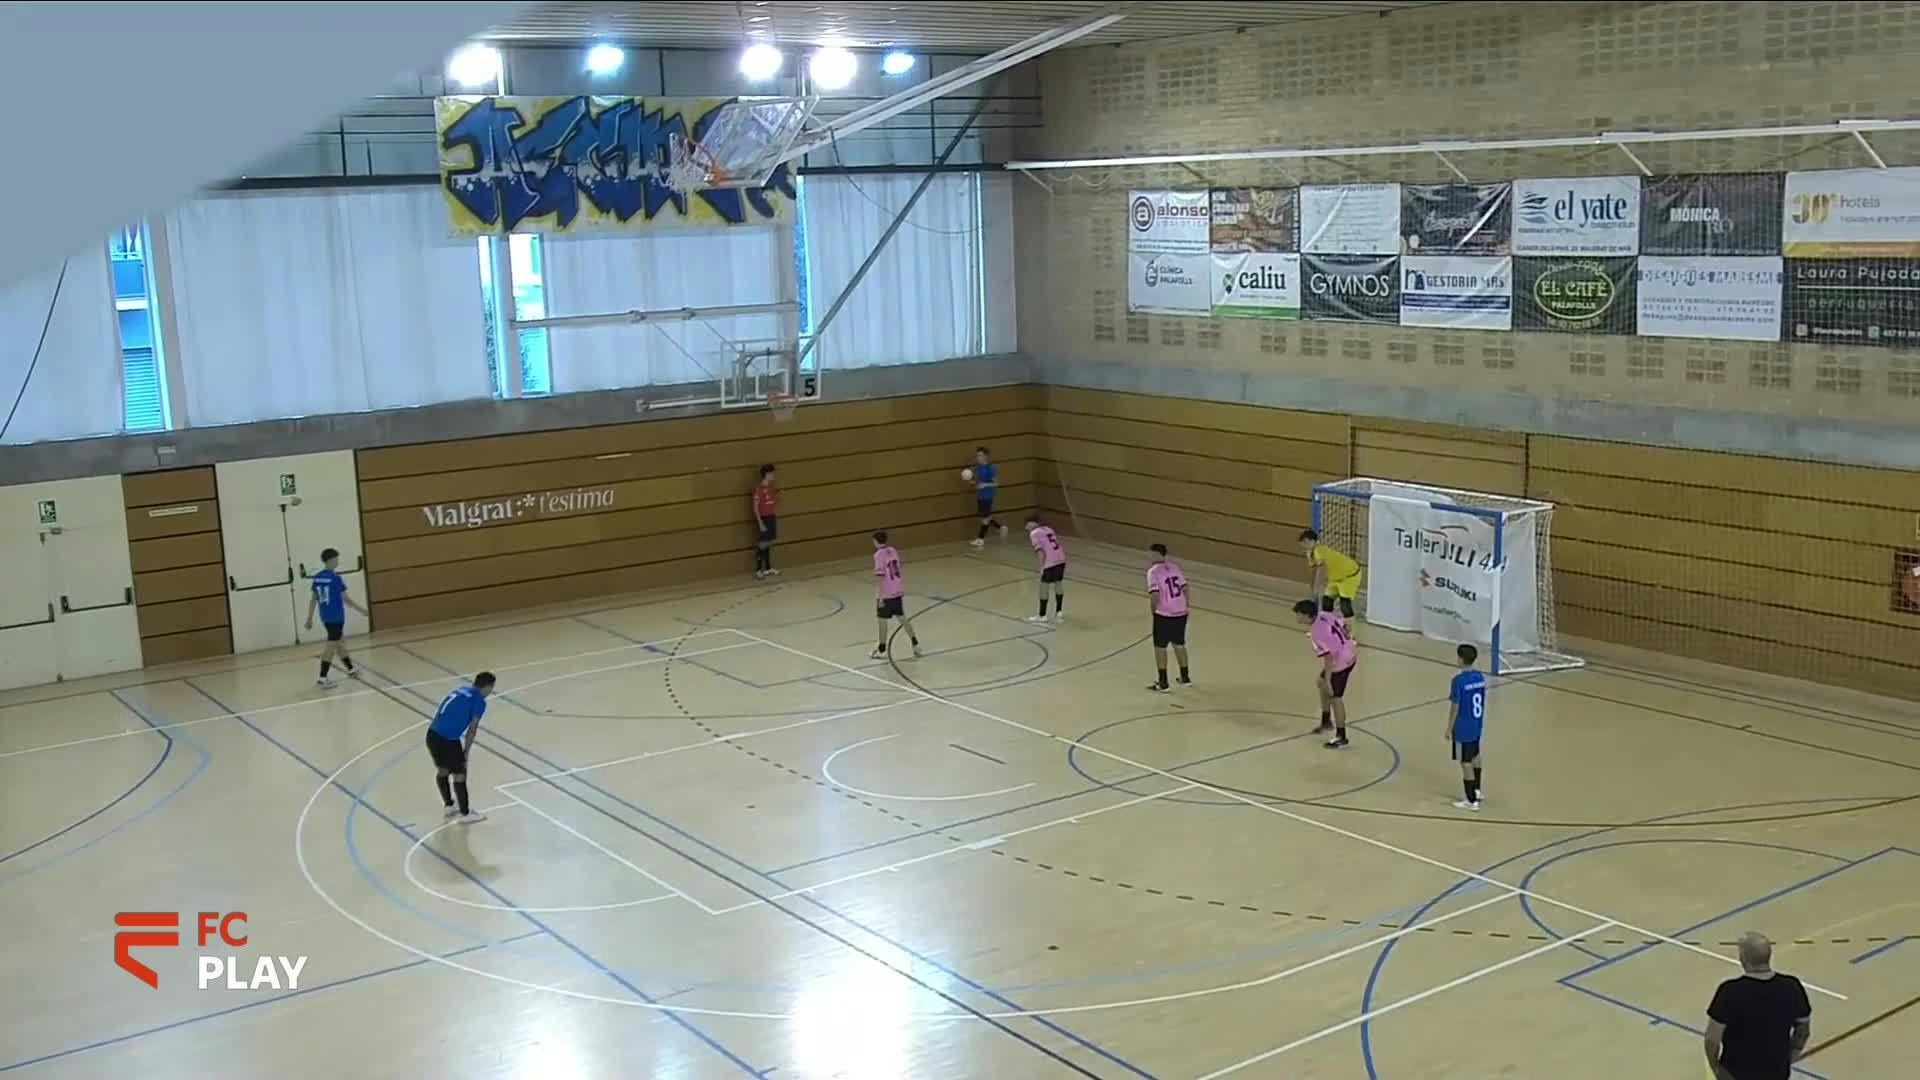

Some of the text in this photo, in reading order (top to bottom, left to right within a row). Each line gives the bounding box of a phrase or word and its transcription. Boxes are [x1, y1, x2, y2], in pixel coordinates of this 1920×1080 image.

[1157, 202, 1208, 217] alonso
[1554, 190, 1627, 229] el yate
[1840, 194, 1881, 208] hotels
[1238, 265, 1287, 290] caliu
[1426, 275, 1477, 288] GESTORIA
[1796, 266, 1848, 279] Laura
[1309, 272, 1390, 297] GYMNOS
[1540, 280, 1561, 296] EL
[804, 378, 816, 397] 5
[1046, 532, 1059, 550] 5
[1393, 527, 1440, 554] Taller
[1164, 575, 1182, 599] 15
[1472, 692, 1483, 719] 8
